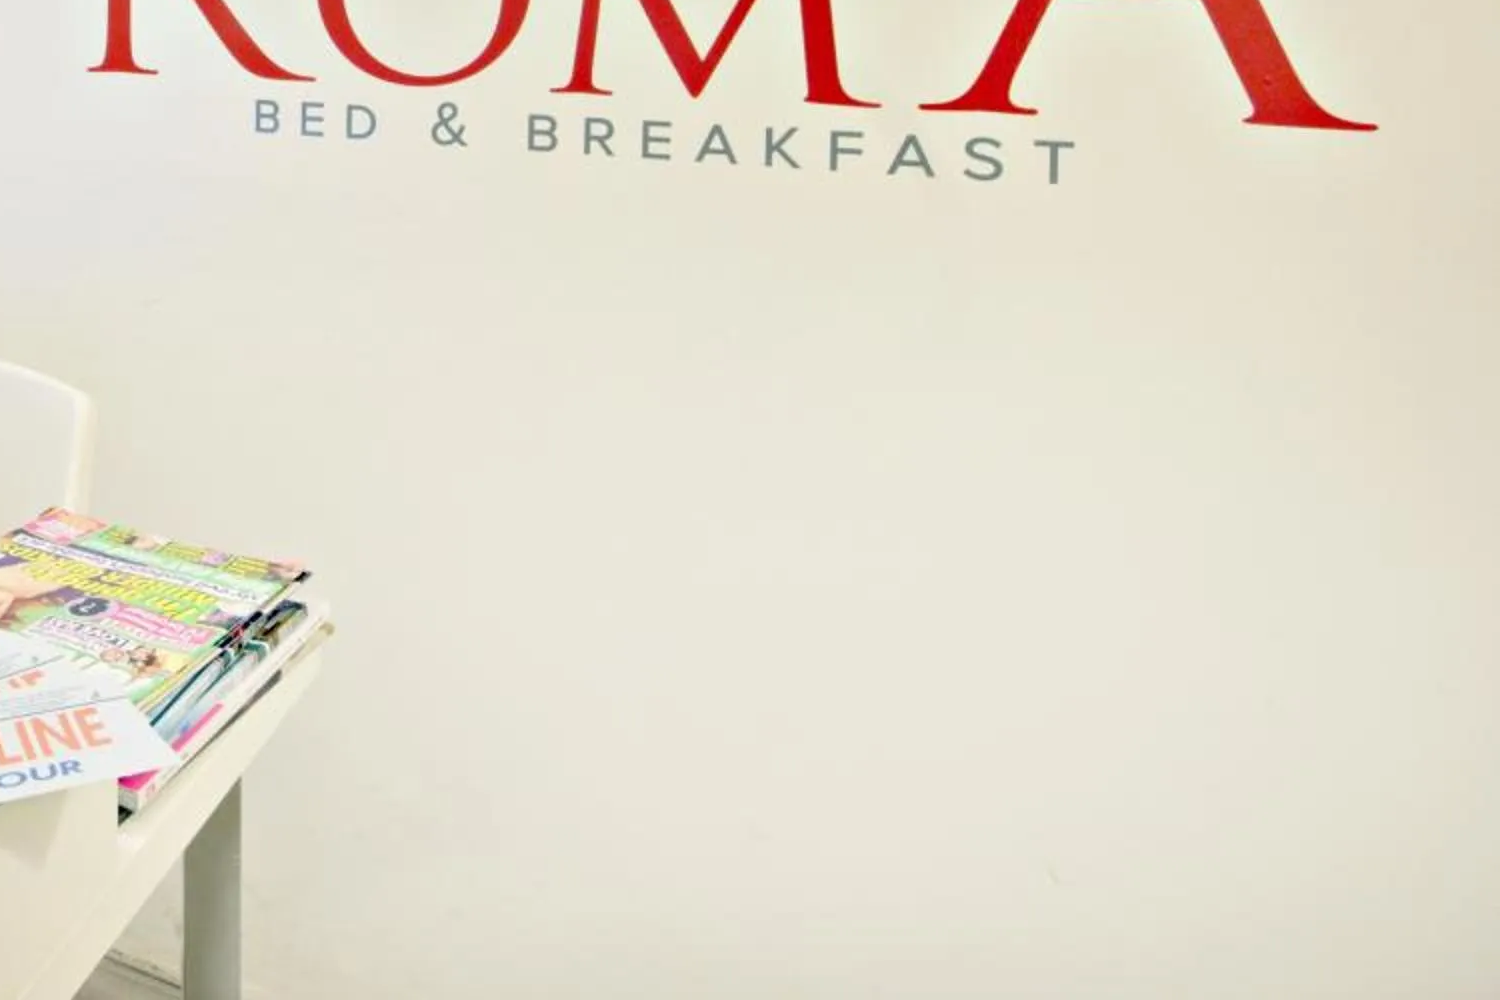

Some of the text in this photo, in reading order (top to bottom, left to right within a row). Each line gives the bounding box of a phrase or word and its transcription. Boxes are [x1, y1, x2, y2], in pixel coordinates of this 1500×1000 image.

[255, 99, 1075, 185] BED & BREAKFAST
